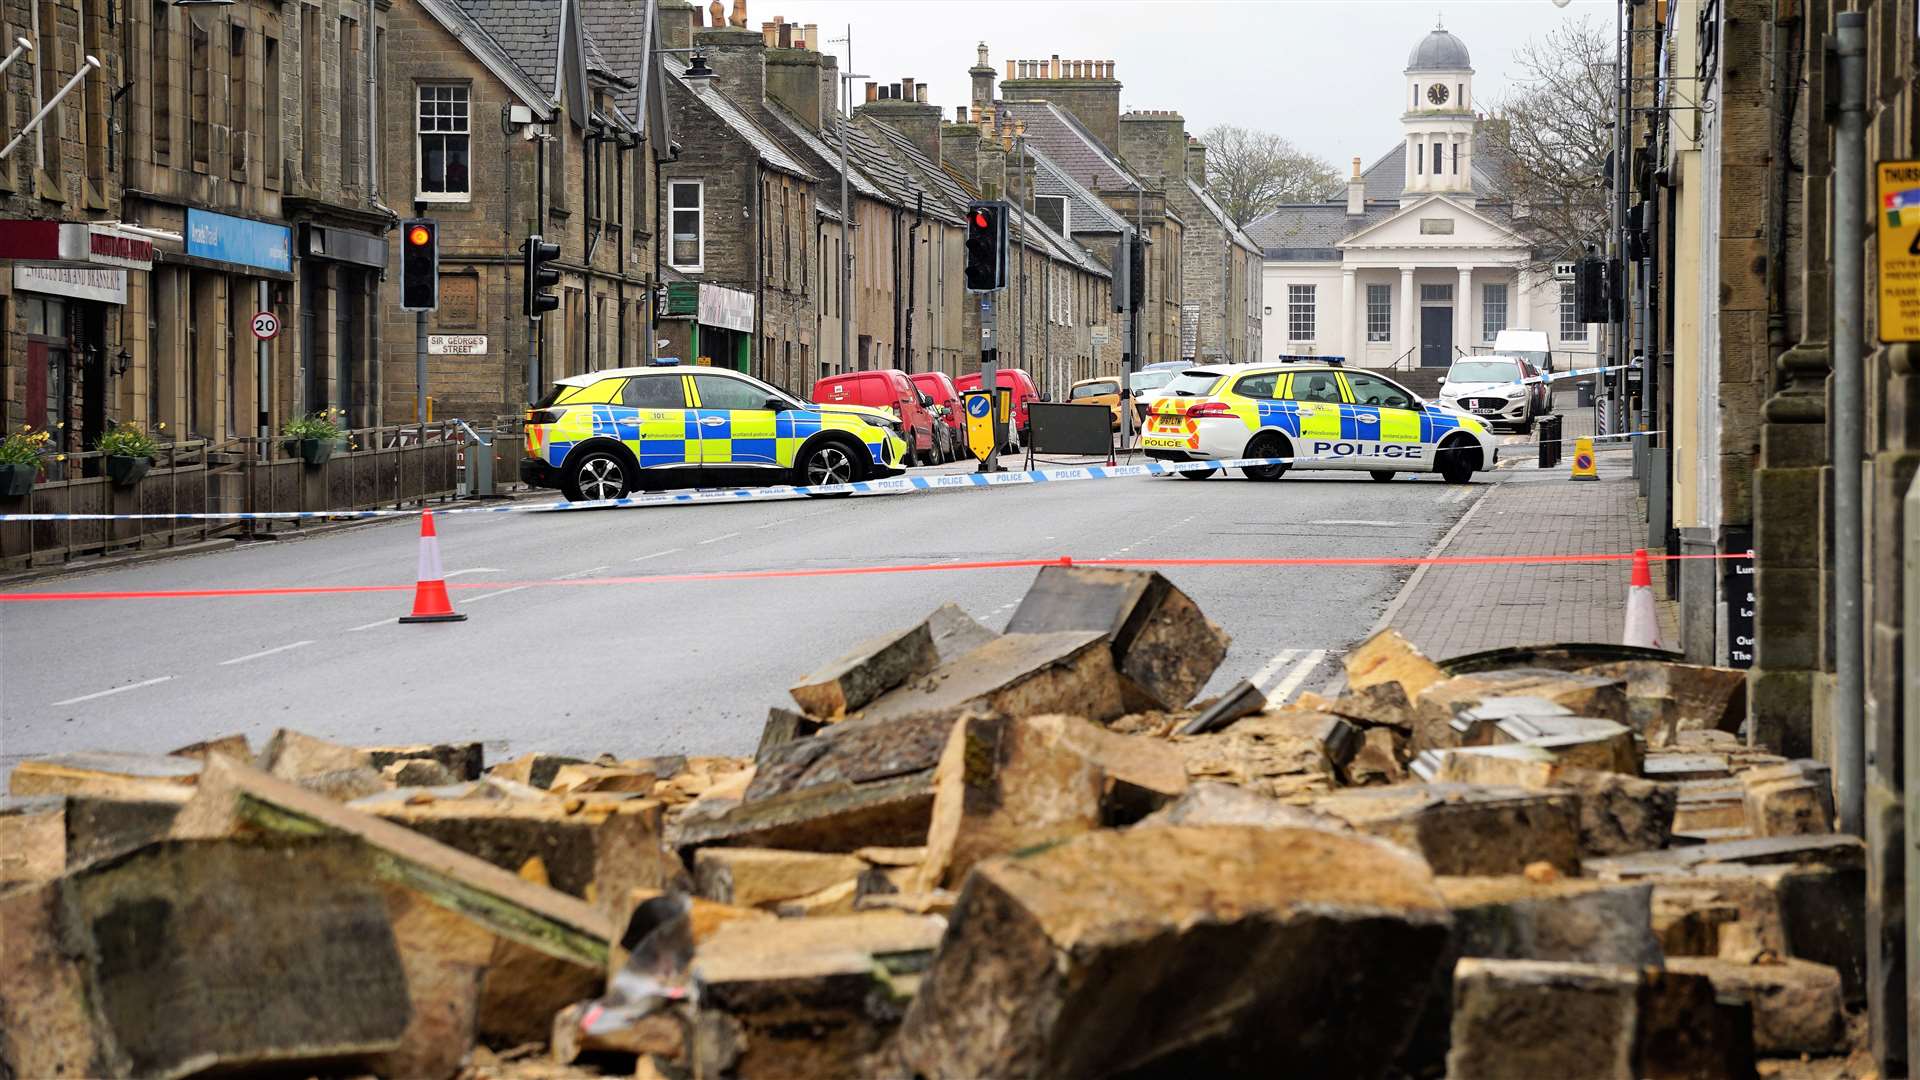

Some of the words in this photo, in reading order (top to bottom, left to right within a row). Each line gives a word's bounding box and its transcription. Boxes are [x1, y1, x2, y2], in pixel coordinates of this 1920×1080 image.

[255, 320, 275, 332] 20
[431, 337, 444, 345] SIR
[1145, 439, 1182, 447] POLICE
[1313, 442, 1423, 458] POLICE
[878, 481, 904, 489] POLICE
[937, 477, 964, 486] POLICE
[996, 474, 1023, 483] POLICE
[1055, 470, 1082, 479] POLICE
[1114, 467, 1141, 475] POLICE
[1174, 463, 1200, 471] POLICE
[1732, 651, 1752, 660] The
